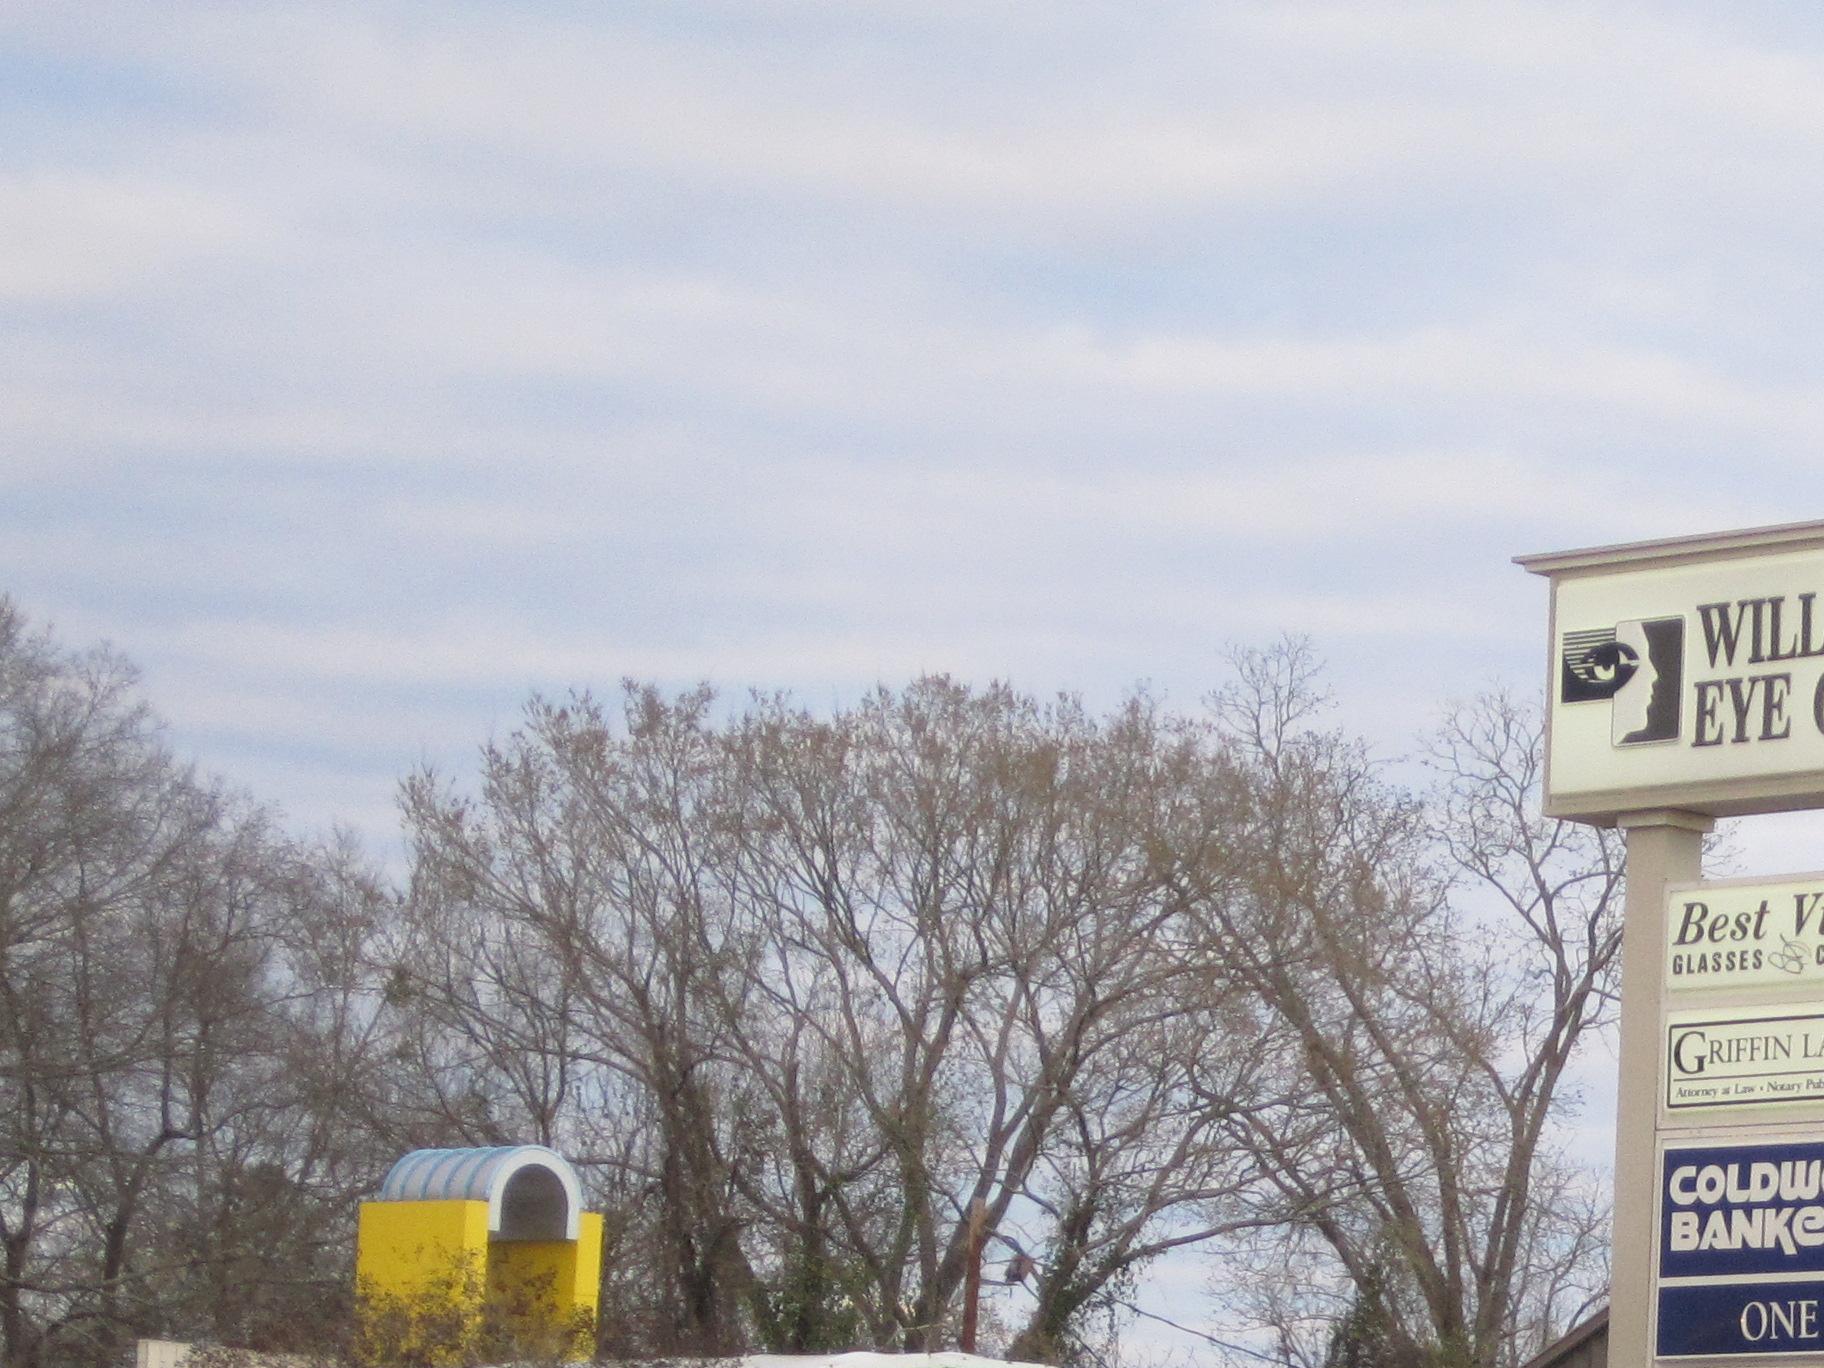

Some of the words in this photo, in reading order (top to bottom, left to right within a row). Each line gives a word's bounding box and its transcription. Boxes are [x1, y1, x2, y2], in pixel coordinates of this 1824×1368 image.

[1691, 672, 1791, 748] EYE
[1672, 900, 1770, 946] Best
[1672, 949, 1763, 976] GLASSES
[1673, 1031, 1792, 1074] GRIFFIN
[1675, 1085, 1718, 1099] Attorney
[1734, 1082, 1755, 1094] Law
[1766, 1080, 1801, 1094] Notary
[1740, 1300, 1819, 1341] ONE
